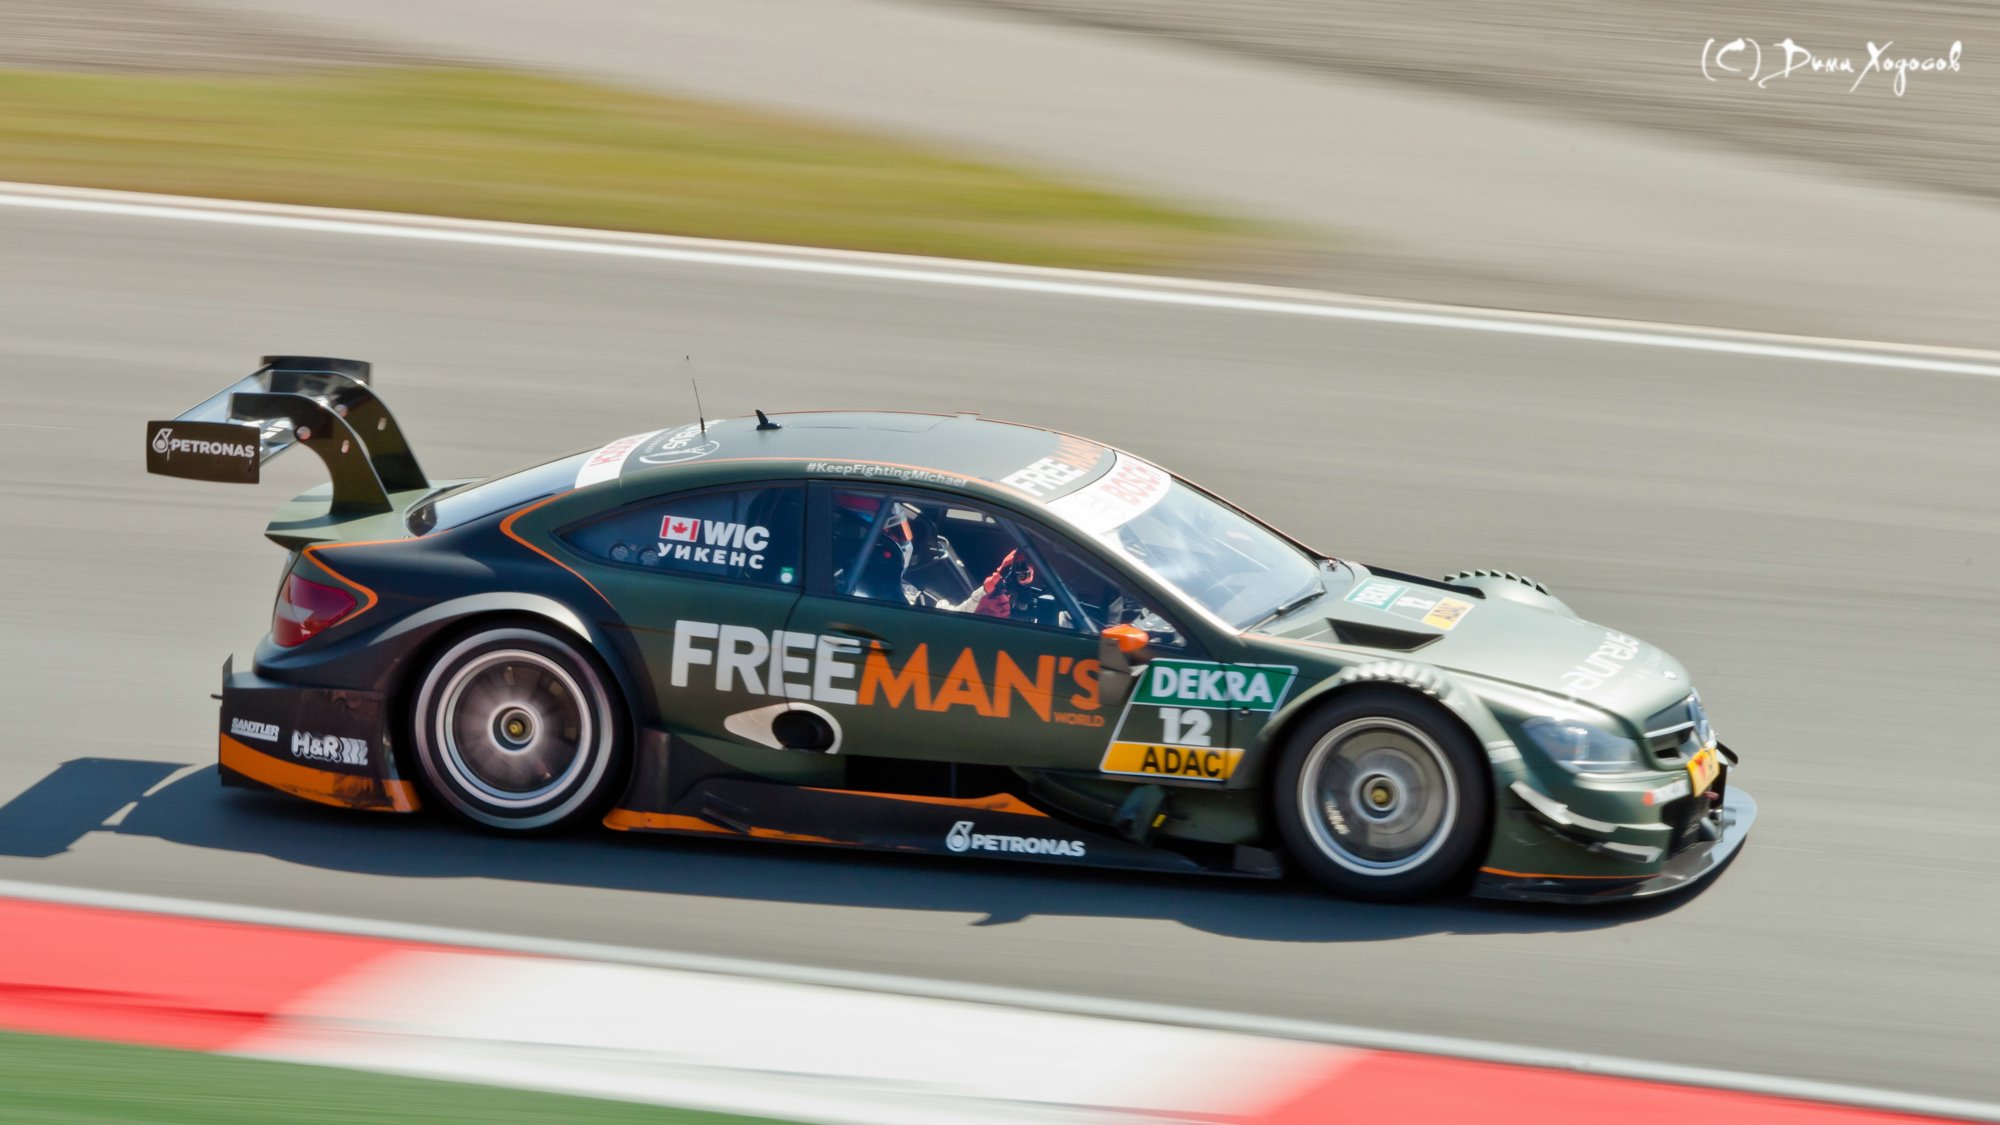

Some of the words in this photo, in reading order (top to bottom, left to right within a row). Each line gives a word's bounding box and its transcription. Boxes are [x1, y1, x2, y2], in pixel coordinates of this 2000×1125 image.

[170, 437, 255, 458] PETRONAS
[806, 462, 968, 487] #KeepFightingMichael
[703, 519, 770, 551] WIC
[657, 542, 765, 570] УИКЕНС
[1151, 666, 1274, 703] DEKRA
[1054, 711, 1105, 728] WORLD
[1159, 706, 1213, 747] 12
[291, 730, 342, 763] H&R
[1141, 746, 1221, 778] ADAC
[971, 833, 1087, 857] PETRONAS
